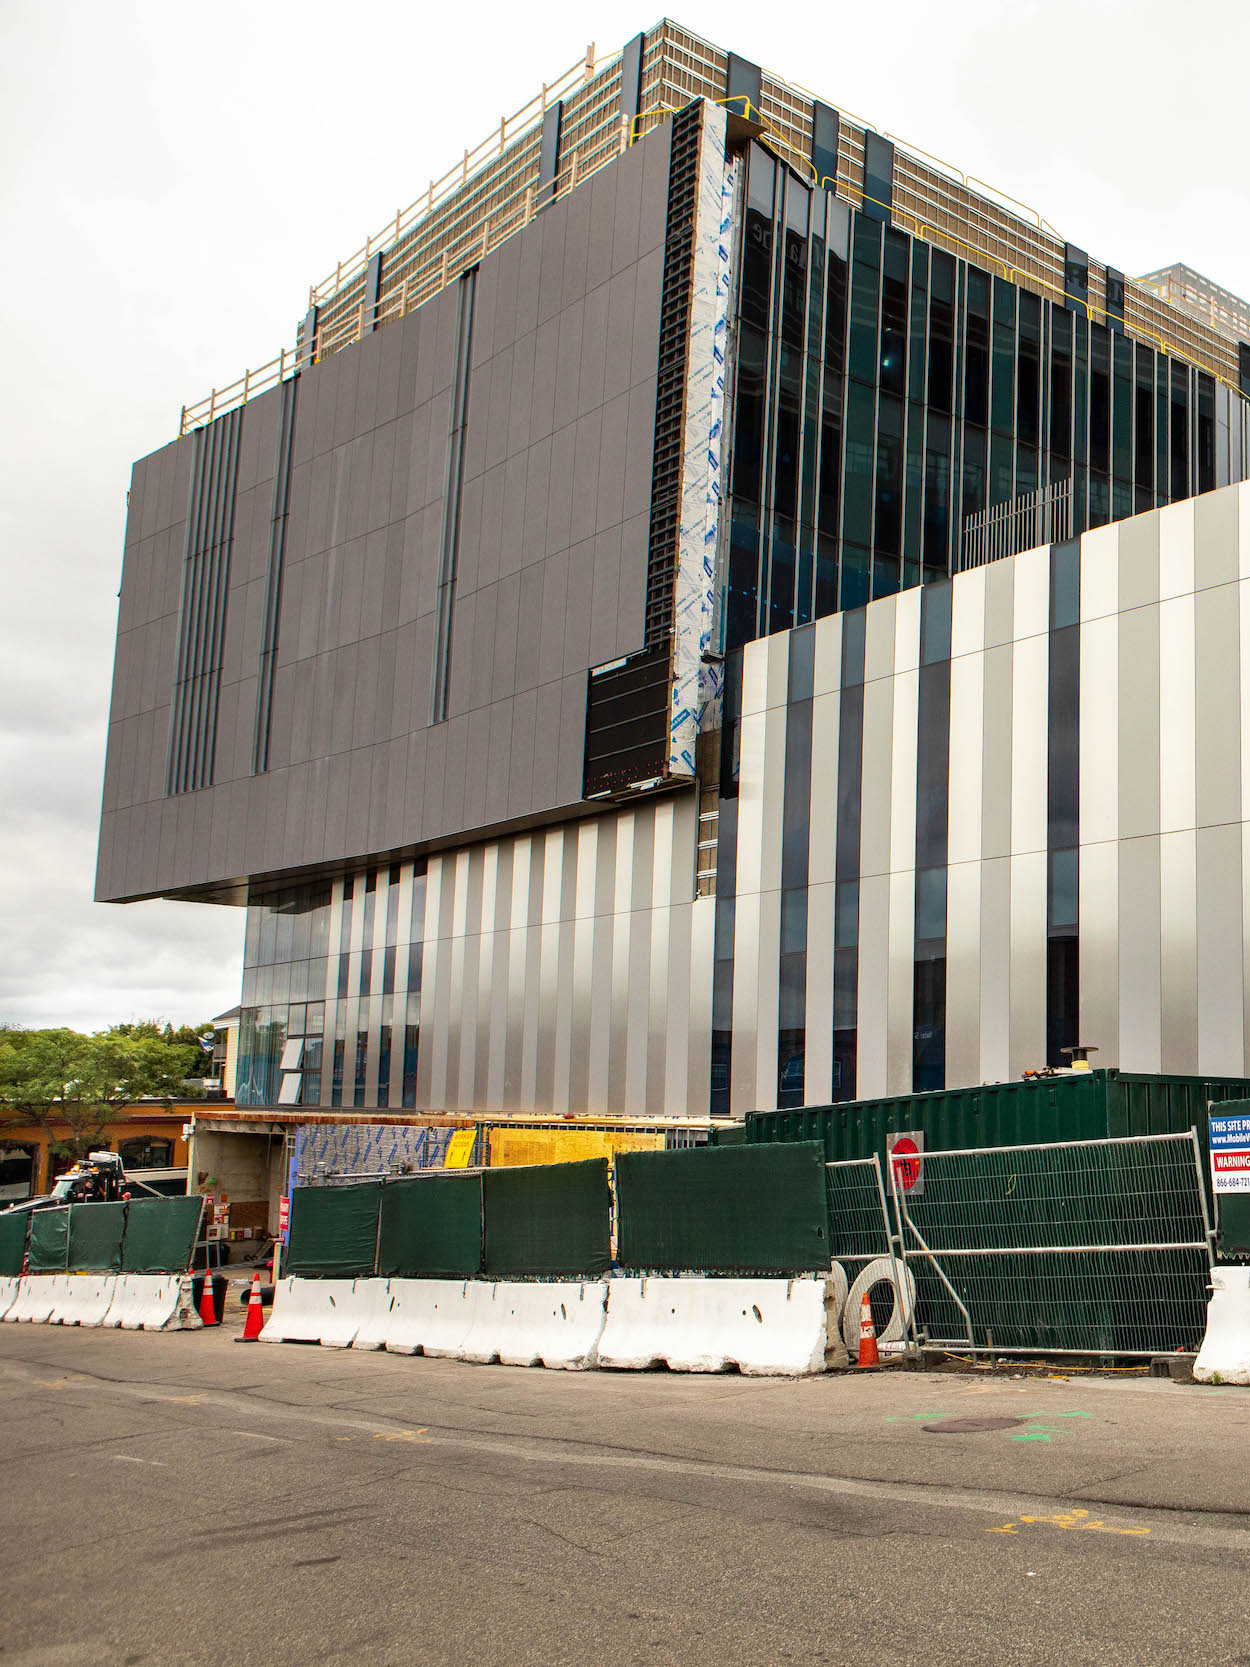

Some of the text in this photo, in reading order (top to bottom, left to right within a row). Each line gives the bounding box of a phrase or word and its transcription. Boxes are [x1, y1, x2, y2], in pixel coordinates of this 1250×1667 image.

[1211, 1121, 1226, 1132] THIS
[1227, 1120, 1241, 1131] SITE
[1216, 1155, 1250, 1168] WARNING
